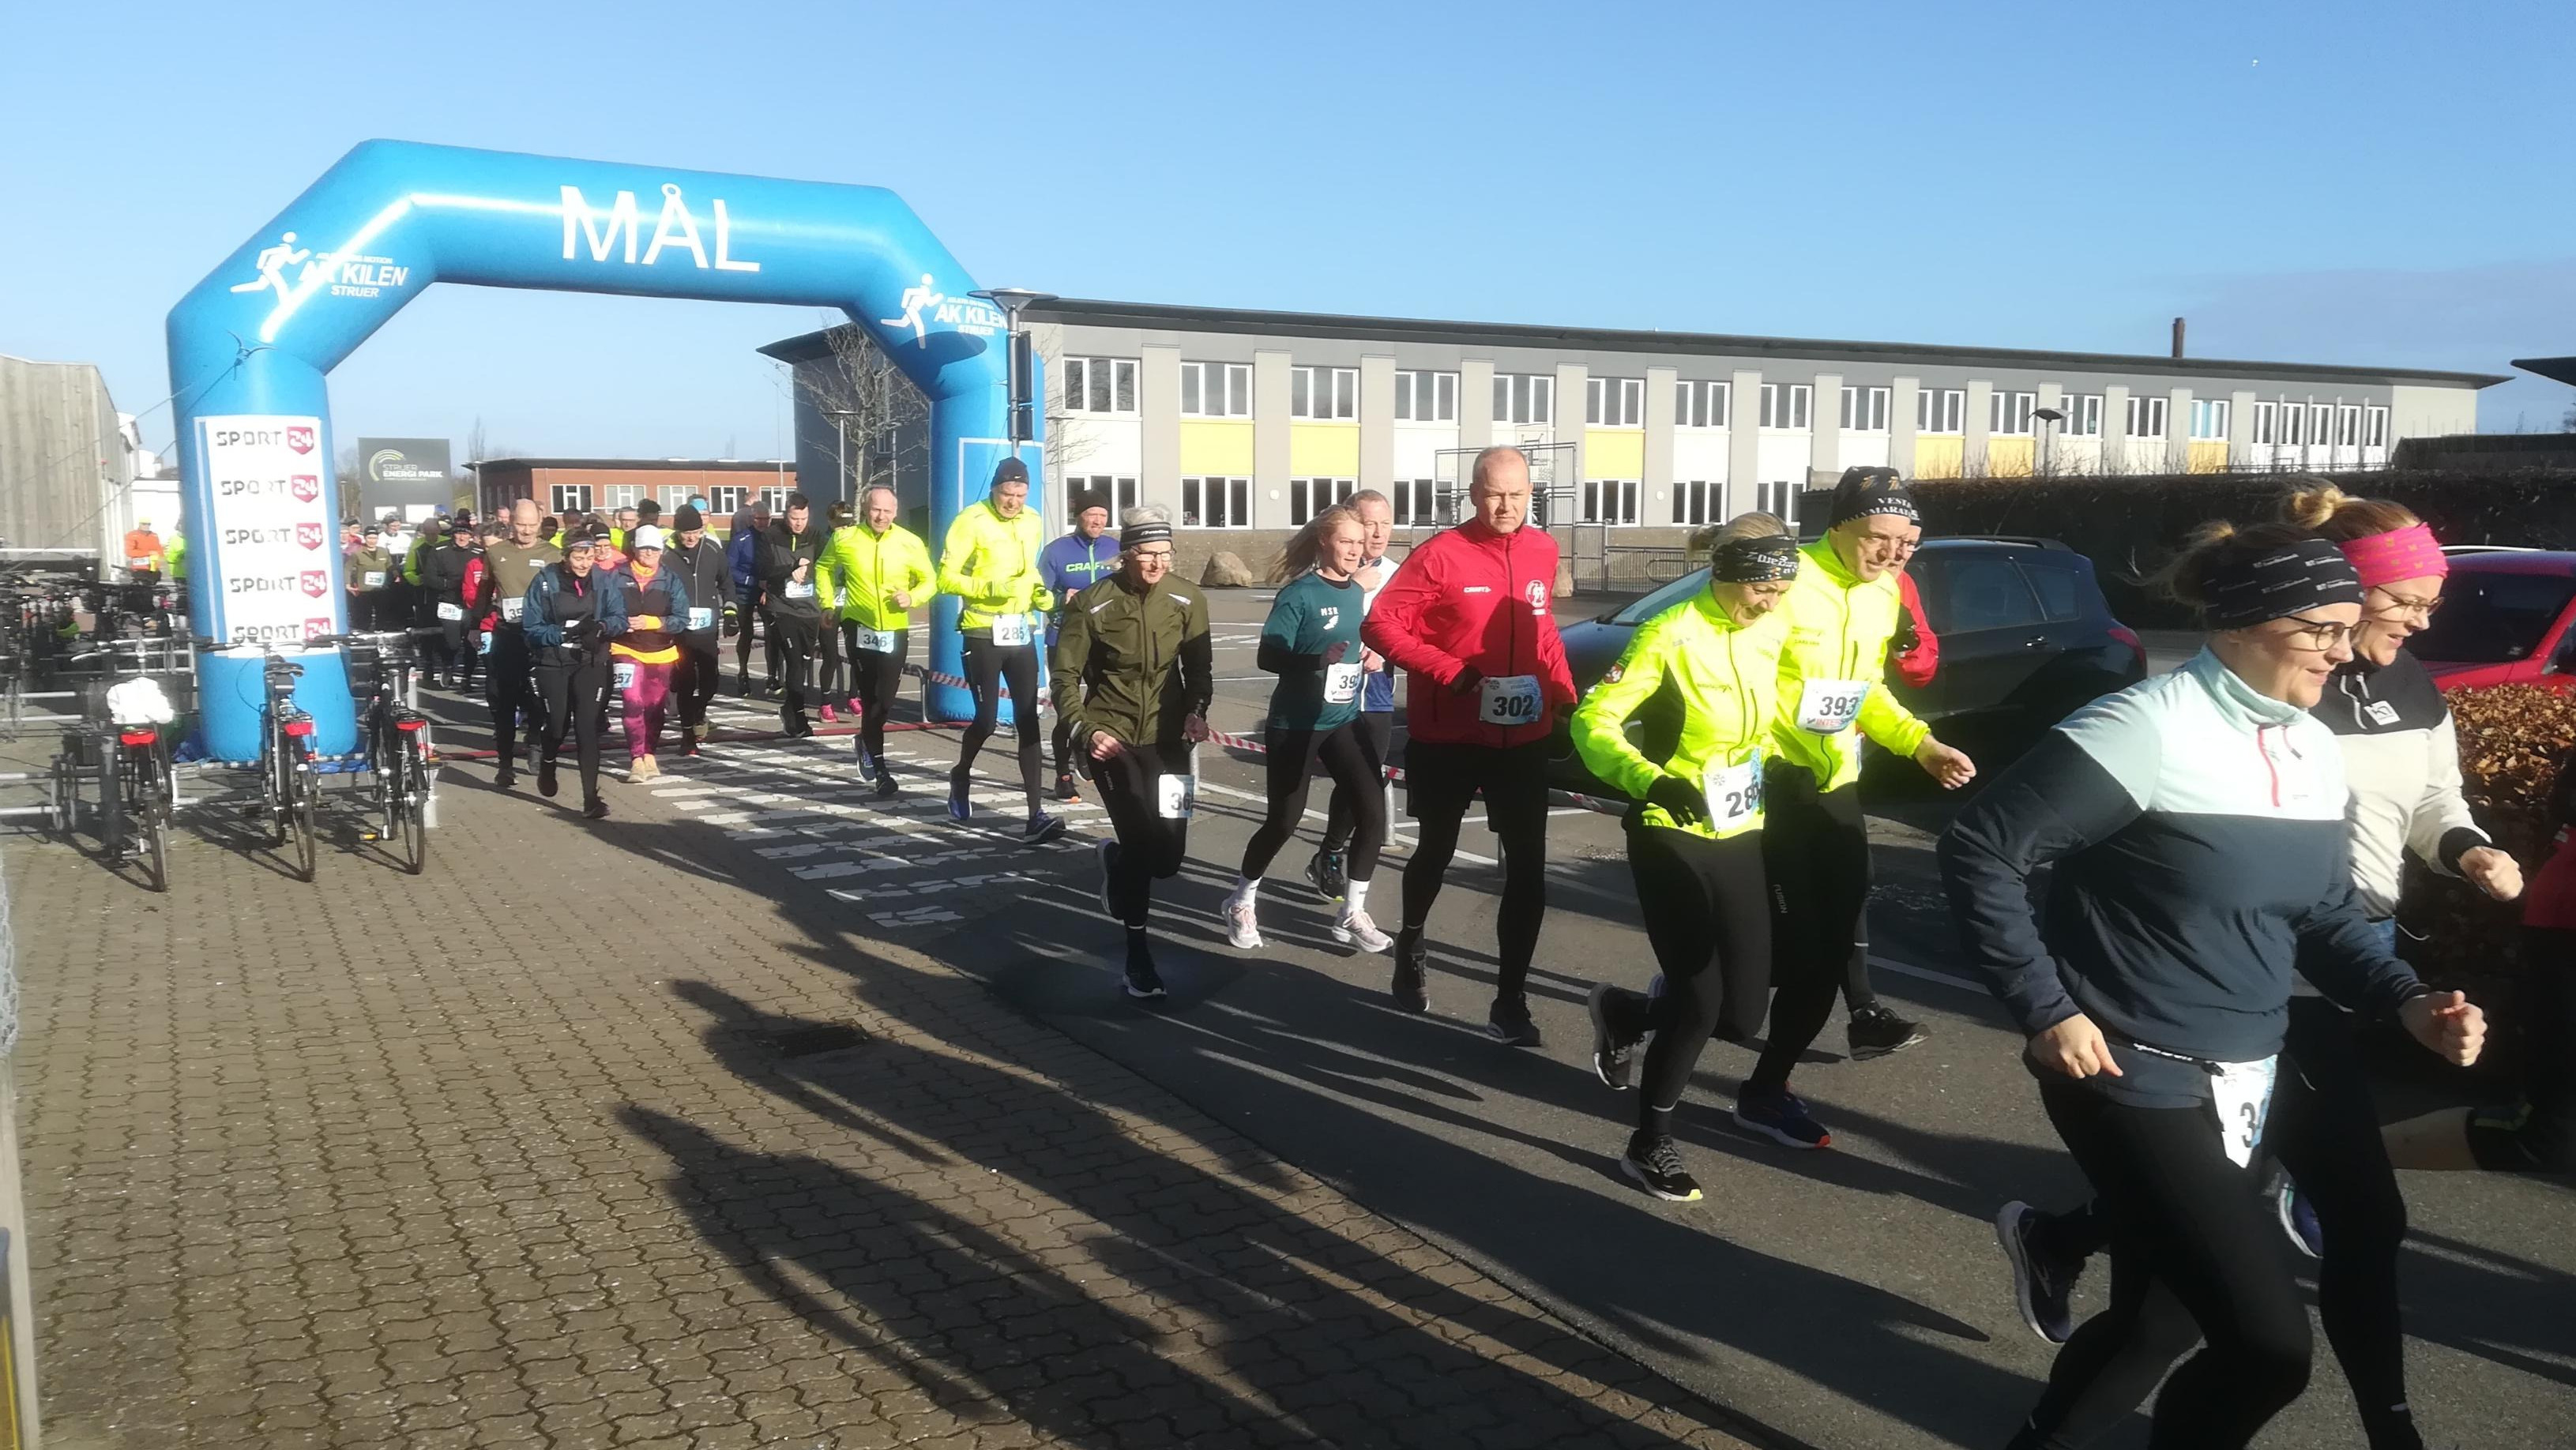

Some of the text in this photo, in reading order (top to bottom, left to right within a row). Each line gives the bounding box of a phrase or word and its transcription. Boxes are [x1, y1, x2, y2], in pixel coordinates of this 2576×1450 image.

[559, 182, 761, 272] MÅL
[341, 263, 409, 287] KILEN
[331, 285, 380, 298] STRUER
[934, 303, 1008, 329] AK KILEN
[216, 430, 314, 448] SPORT 24
[292, 478, 318, 496] 24
[1868, 506, 1912, 517] MARAT
[297, 527, 323, 544] 24
[1065, 562, 1105, 573] CRAF
[229, 574, 326, 593] SPORT 24
[234, 621, 331, 642] SPORT 24
[863, 633, 888, 648] 346
[1001, 626, 1025, 640] 285
[613, 673, 632, 684] 257
[1492, 695, 1534, 717] 302
[1819, 696, 1860, 716] 393
